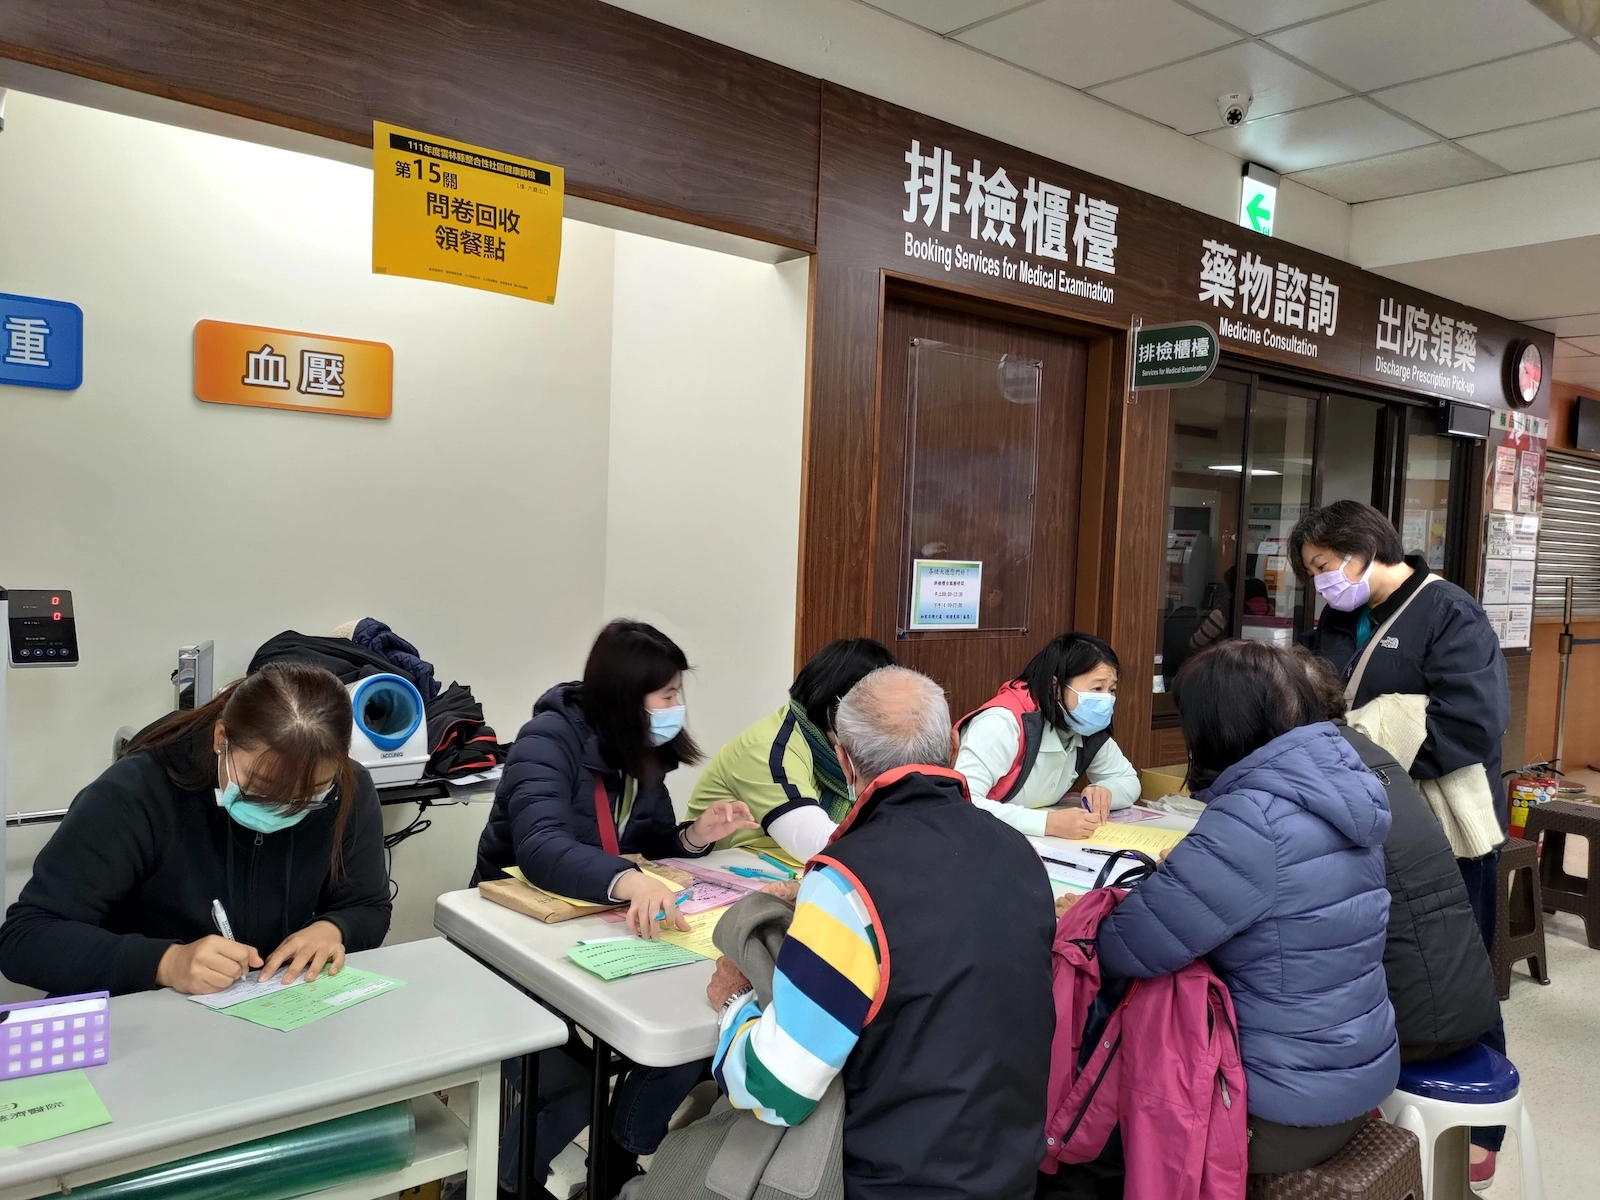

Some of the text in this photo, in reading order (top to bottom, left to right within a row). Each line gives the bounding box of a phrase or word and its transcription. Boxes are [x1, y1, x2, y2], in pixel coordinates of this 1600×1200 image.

[395, 158, 458, 190] 第15關
[426, 191, 521, 235] 問卷回收
[435, 224, 506, 262] 領餐點
[905, 231, 1114, 304] Booking Services for Medical Examination
[1198, 239, 1340, 337] 藥物諮詢
[5, 317, 50, 367] 重
[1219, 316, 1318, 358] Medicine Consultation
[1376, 297, 1478, 373] 出院領藥
[243, 346, 345, 397] 血壓
[1141, 369, 1159, 377] Services
[1166, 366, 1181, 374] Medical
[1181, 364, 1207, 373] Examination
[1375, 355, 1475, 397] Discharge Prescription Pick-up
[51, 596, 60, 605] 0
[53, 612, 62, 620] 0
